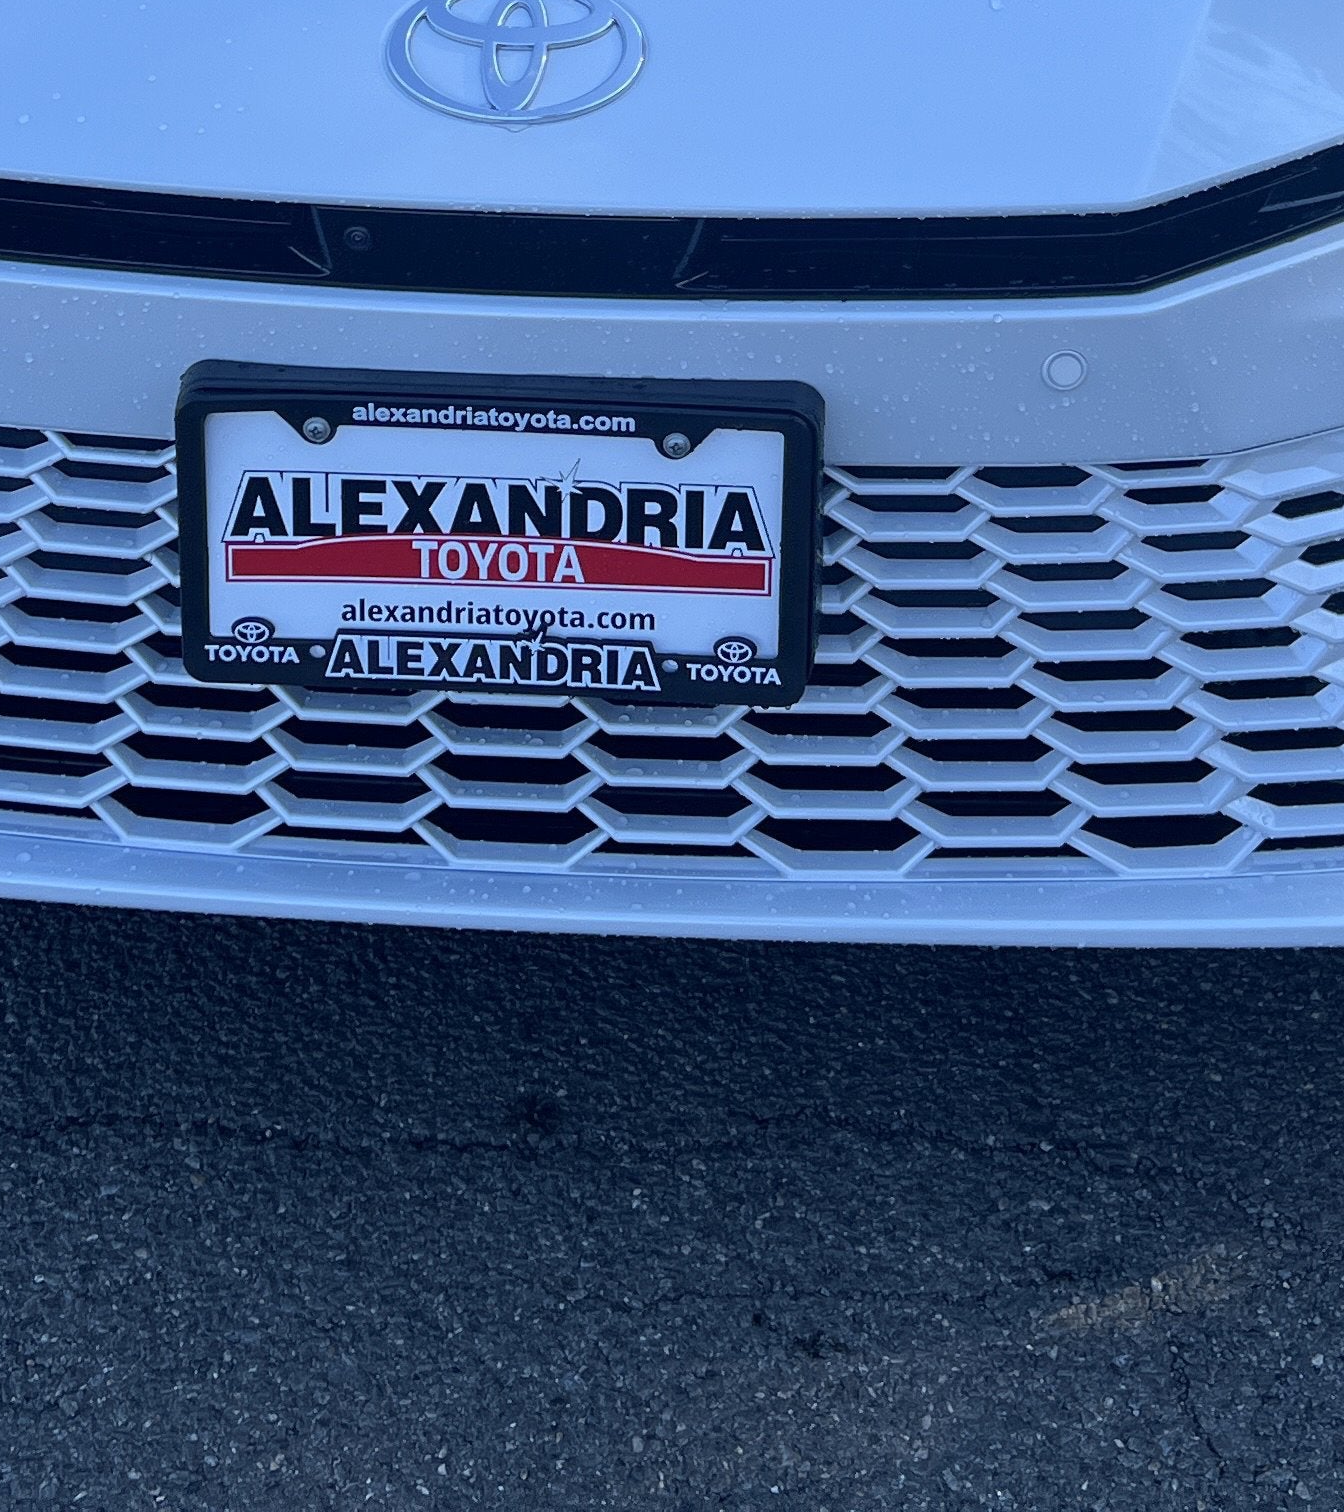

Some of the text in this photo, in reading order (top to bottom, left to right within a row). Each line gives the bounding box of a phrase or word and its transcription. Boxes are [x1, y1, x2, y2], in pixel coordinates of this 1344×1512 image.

[352, 402, 636, 432] alexandriatoyota.com
[225, 472, 771, 555] ALEXANDRIA
[411, 540, 585, 583] TOYOTA
[341, 598, 655, 634] alexandriatoyota.com
[204, 644, 300, 664] TOYOTA
[326, 634, 660, 691] ALEXANDRIA
[686, 663, 782, 685] TOYOTA
